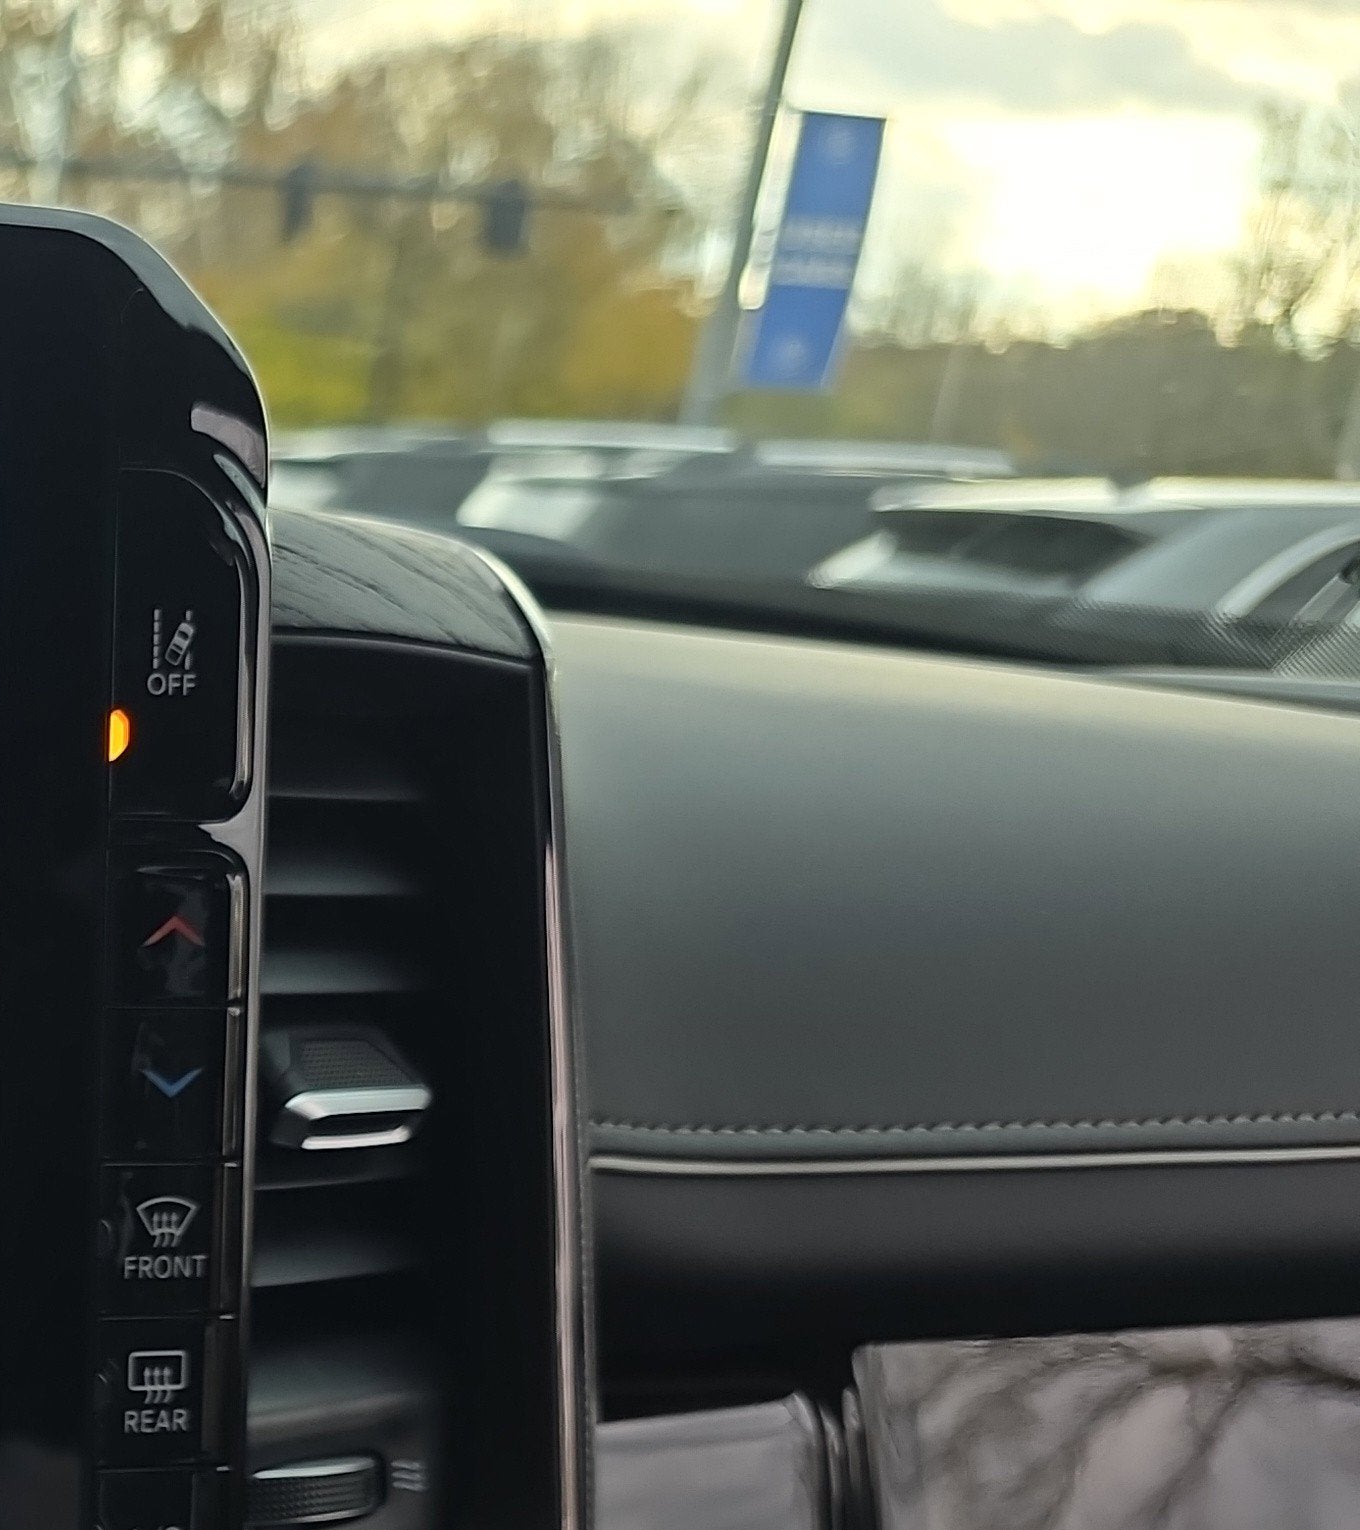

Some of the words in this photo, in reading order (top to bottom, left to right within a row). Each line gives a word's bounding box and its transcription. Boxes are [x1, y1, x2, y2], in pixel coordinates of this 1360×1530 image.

[147, 672, 197, 697] OFF
[124, 1254, 208, 1280] FRONT
[124, 1409, 188, 1434] REAR
